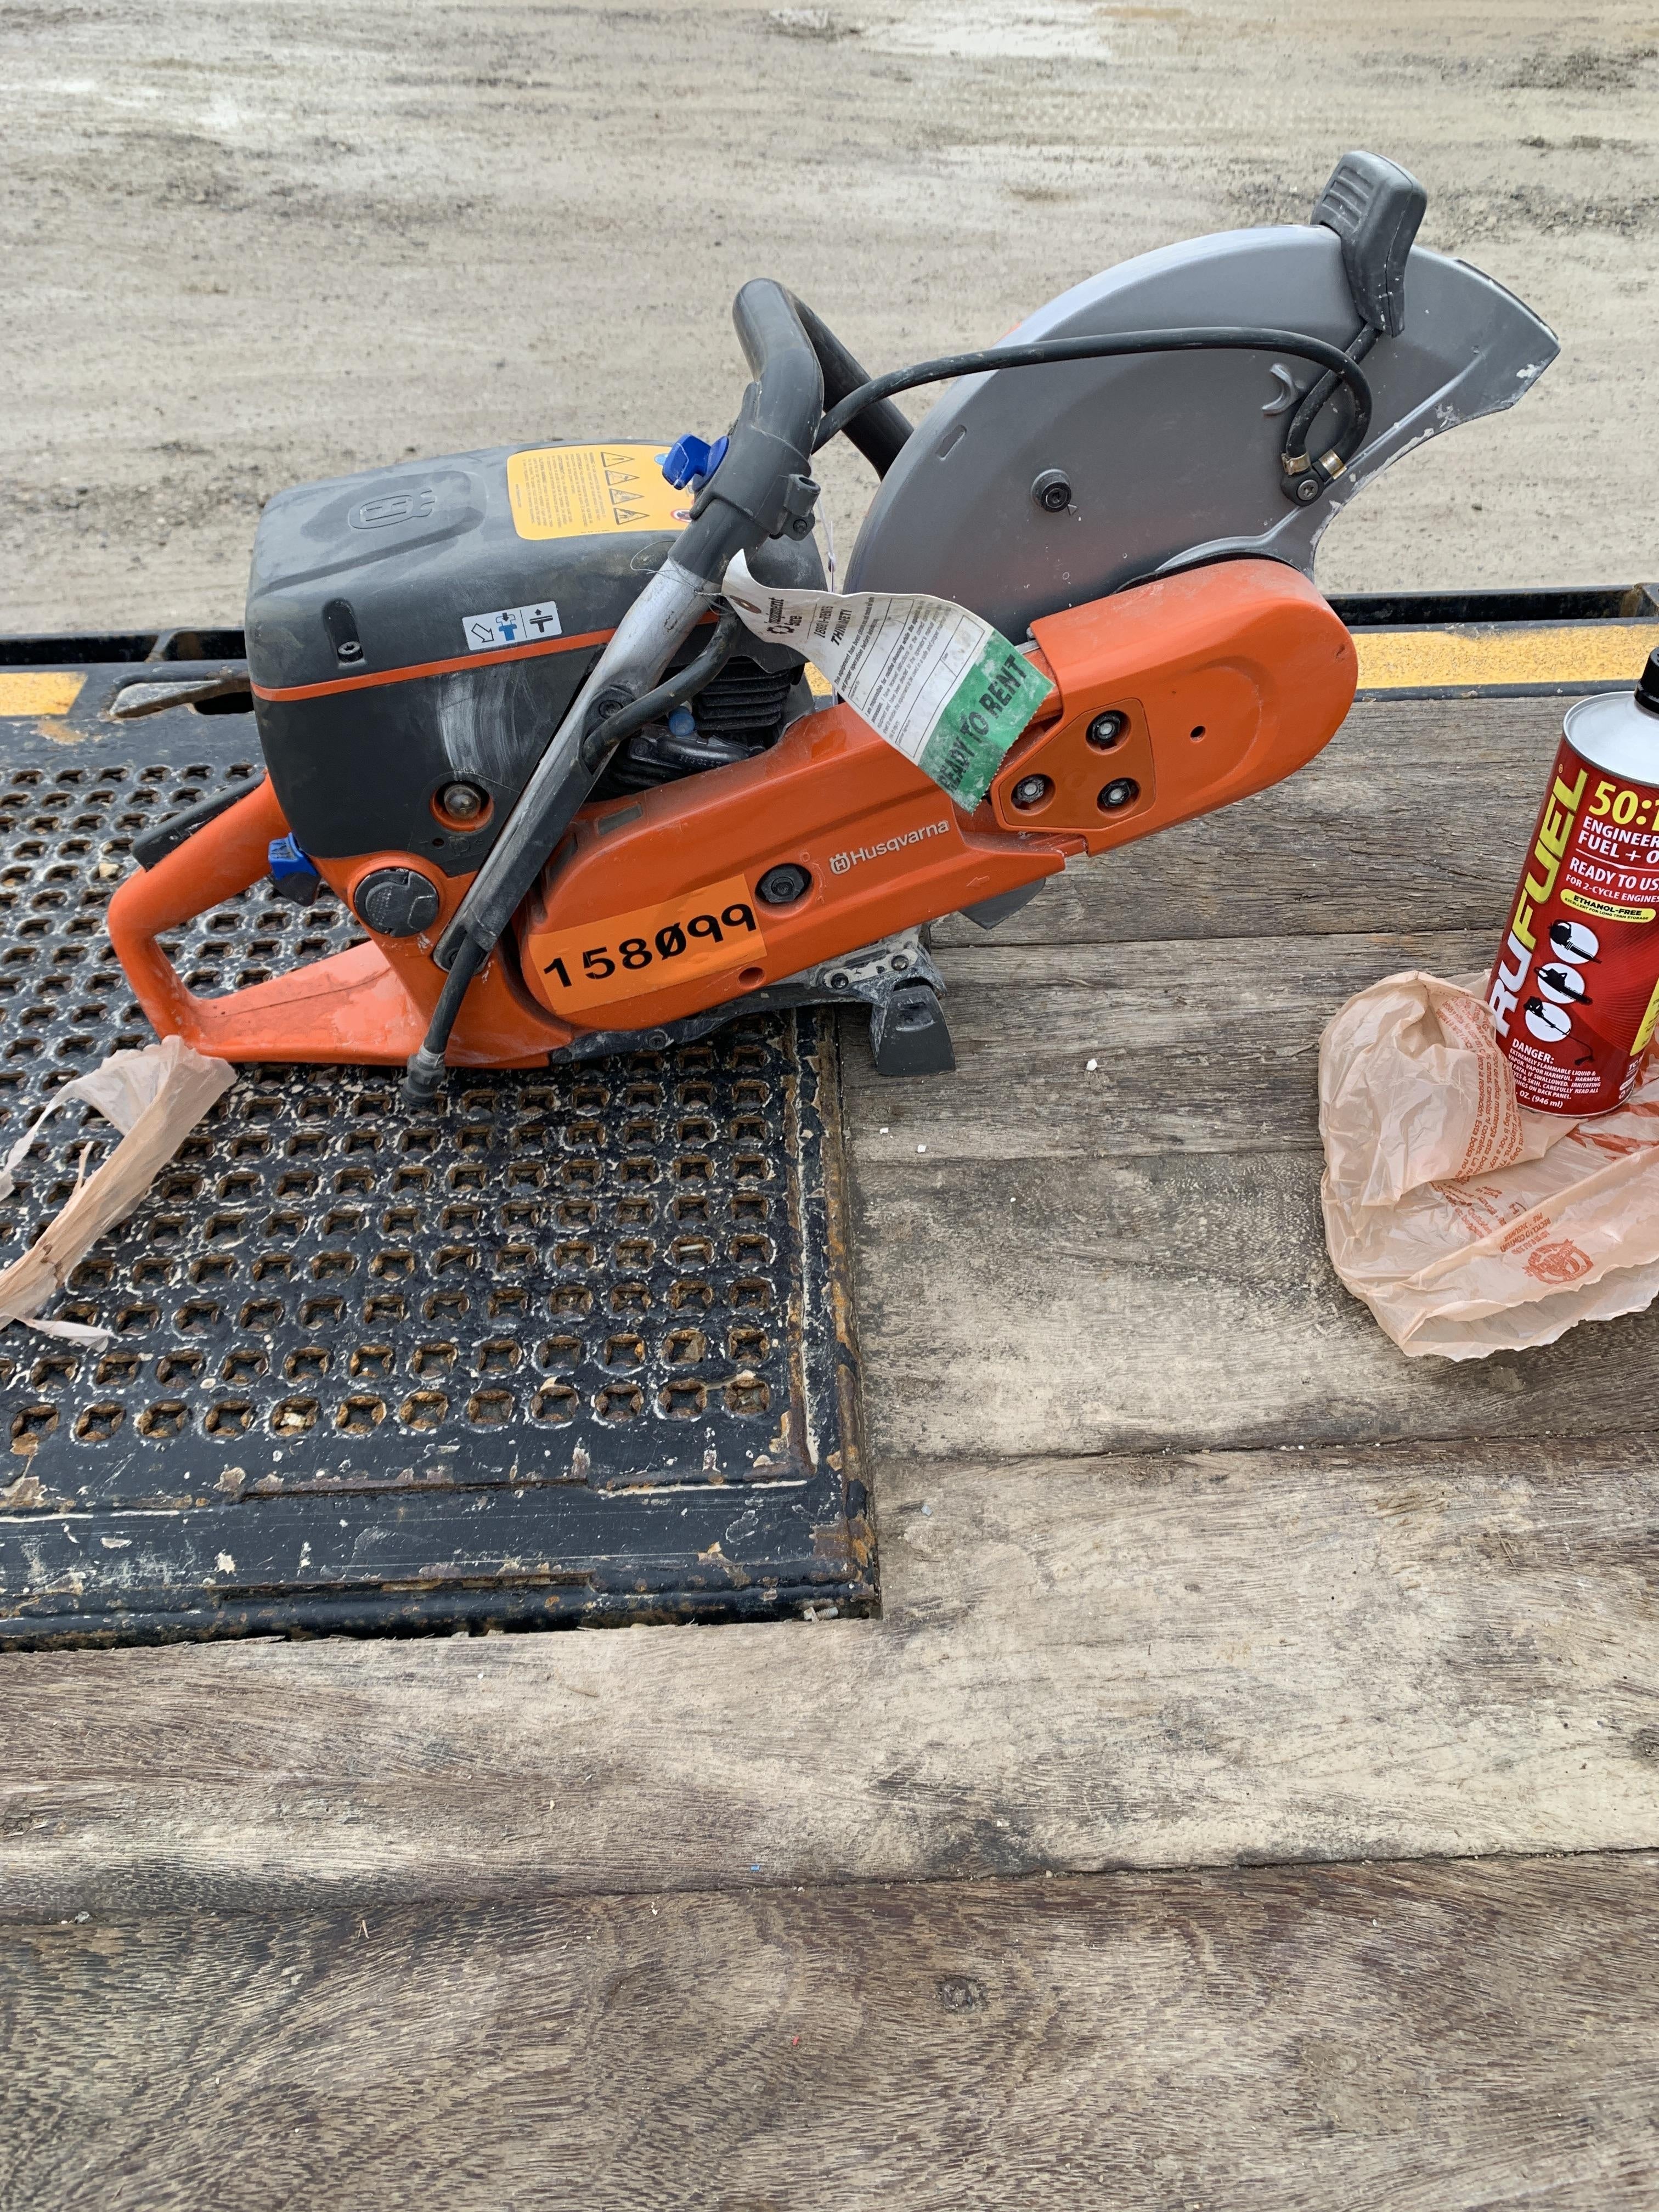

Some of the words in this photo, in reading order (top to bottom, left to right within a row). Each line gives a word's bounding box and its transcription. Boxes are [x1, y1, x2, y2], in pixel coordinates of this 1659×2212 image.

[838, 654, 850, 676] equipment
[850, 649, 863, 670] operation
[870, 685, 883, 707] responsible
[936, 735, 976, 793] READY
[960, 710, 992, 743] TO
[978, 654, 1029, 720] RENT
[850, 820, 949, 865] Husqvarna
[1583, 815, 1659, 848] ENGINEER
[1578, 830, 1619, 858] FUEL
[1646, 850, 1659, 864] O
[1569, 856, 1616, 884] READY
[1618, 874, 1637, 889] TO
[1639, 877, 1659, 891] US
[1565, 874, 1582, 888] FOR
[1583, 883, 1620, 899] 2-CYCLE
[1489, 768, 1588, 1037] RUFUEL
[1565, 898, 1588, 910] EXCELLENT
[1573, 895, 1643, 916] ETHANOL-FREE
[1509, 1048, 1538, 1065] EXTREMELY
[1537, 1062, 1571, 1075] FLAMMABLE
[1511, 1038, 1555, 1064] DANGER:
[1508, 1054, 1525, 1067] VAPOR.
[1526, 1063, 1544, 1075] VAPOR
[1544, 1071, 1573, 1081] HARMFUL.
[1513, 1064, 1527, 1075] FATAL
[1533, 1073, 1569, 1087] SWALLOWED.
[1513, 1071, 1522, 1080] YES
[1527, 1078, 1542, 1087] SKIN.
[1542, 1084, 1573, 1093] CAREFULLY
[1515, 1080, 1528, 1089] INGS
[1537, 1088, 1552, 1096] BACK
[1520, 1090, 1531, 1100] OZ.
[1532, 1094, 1549, 1105] (946
[1549, 1100, 1563, 1108] ml)
